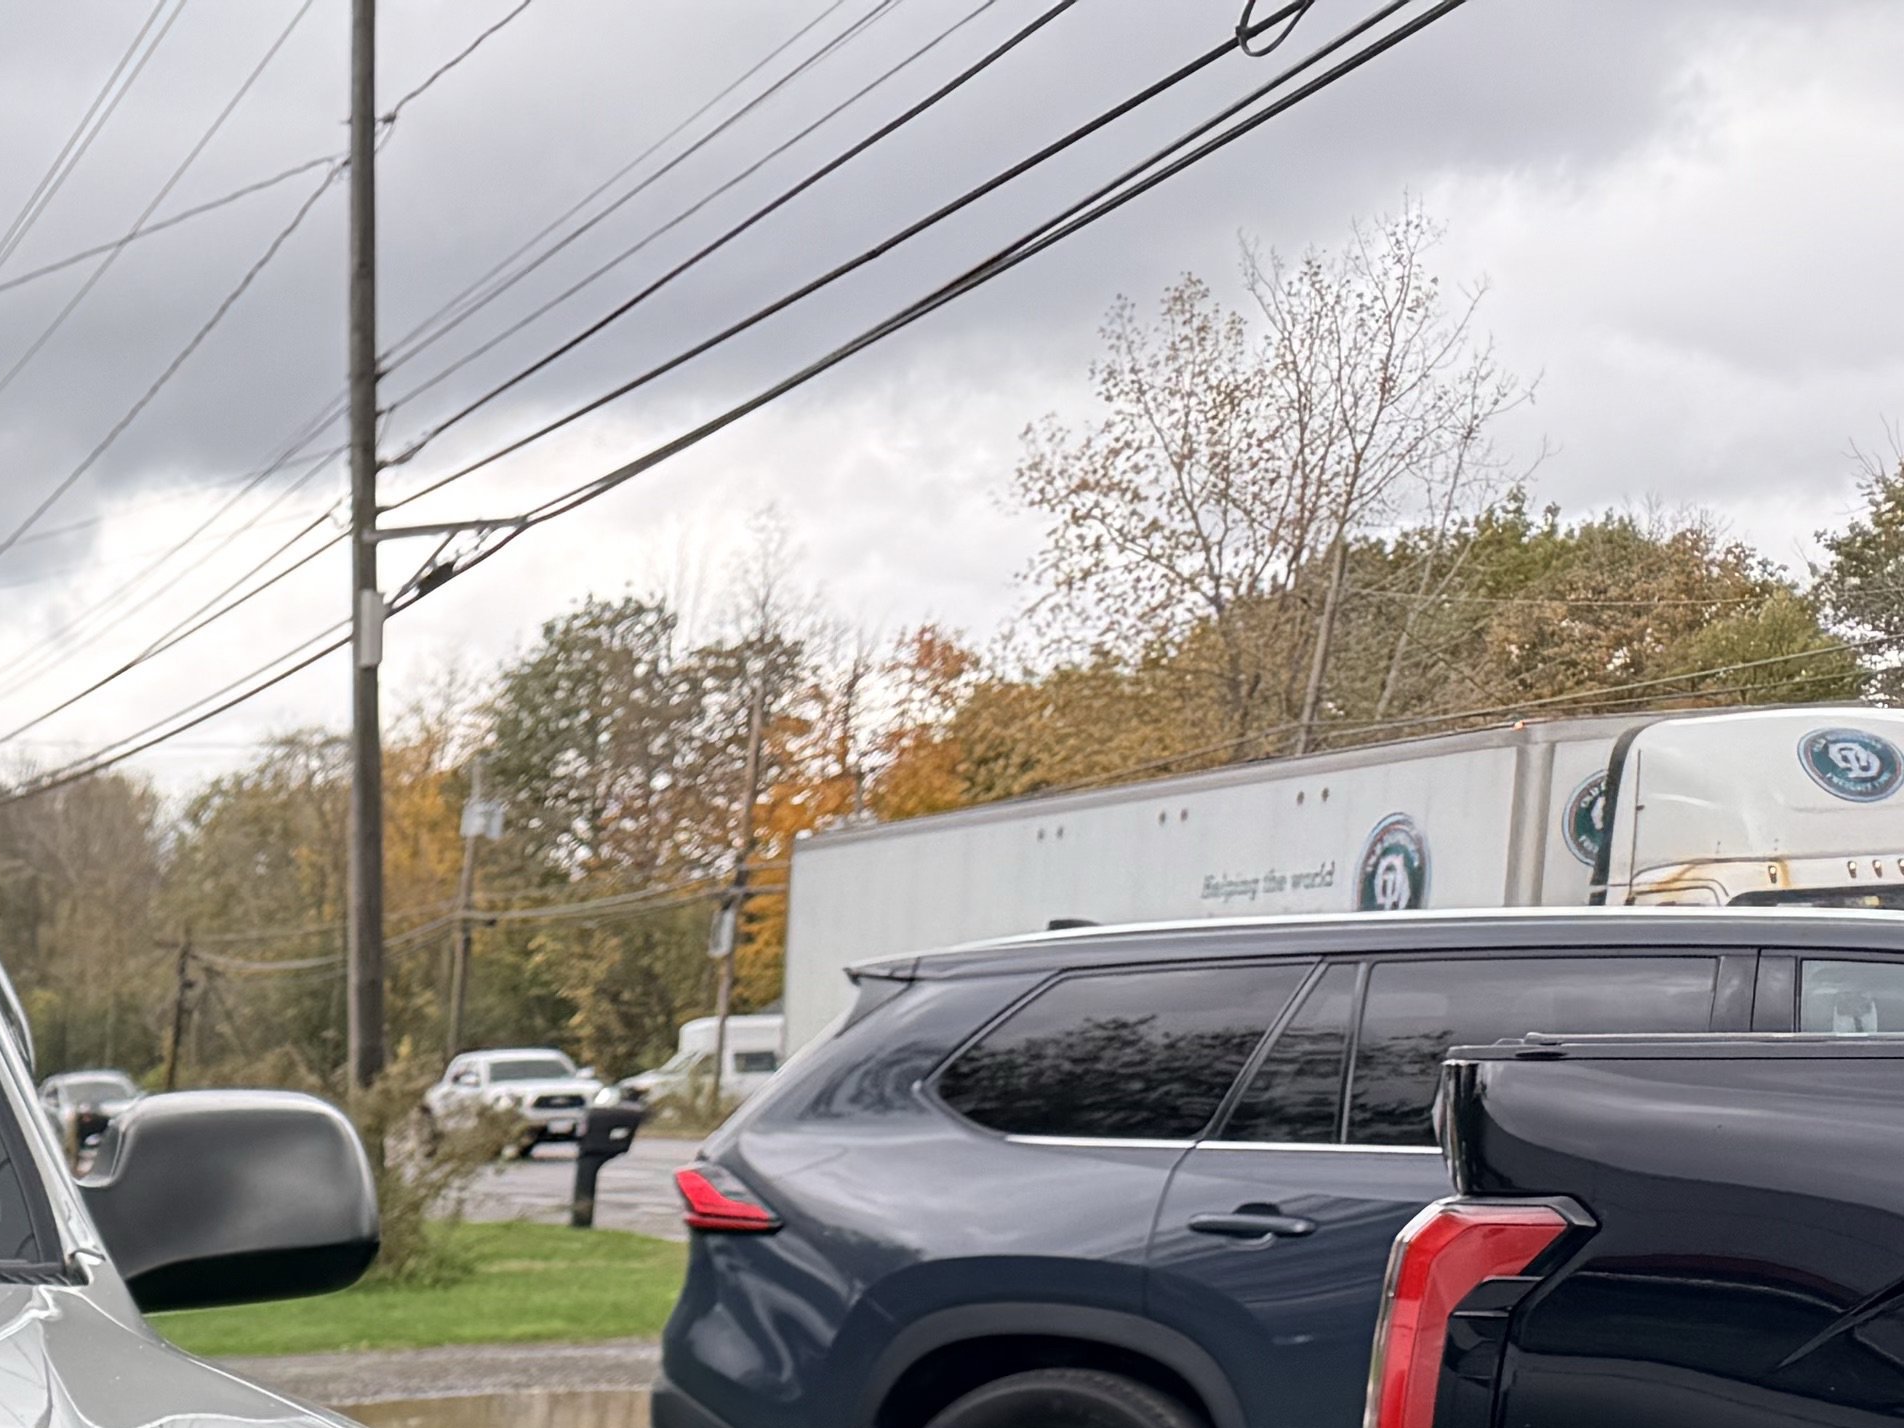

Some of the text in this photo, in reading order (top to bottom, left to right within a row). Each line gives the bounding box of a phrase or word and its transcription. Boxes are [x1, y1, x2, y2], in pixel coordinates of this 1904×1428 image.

[1201, 860, 1336, 903] Helping the world
